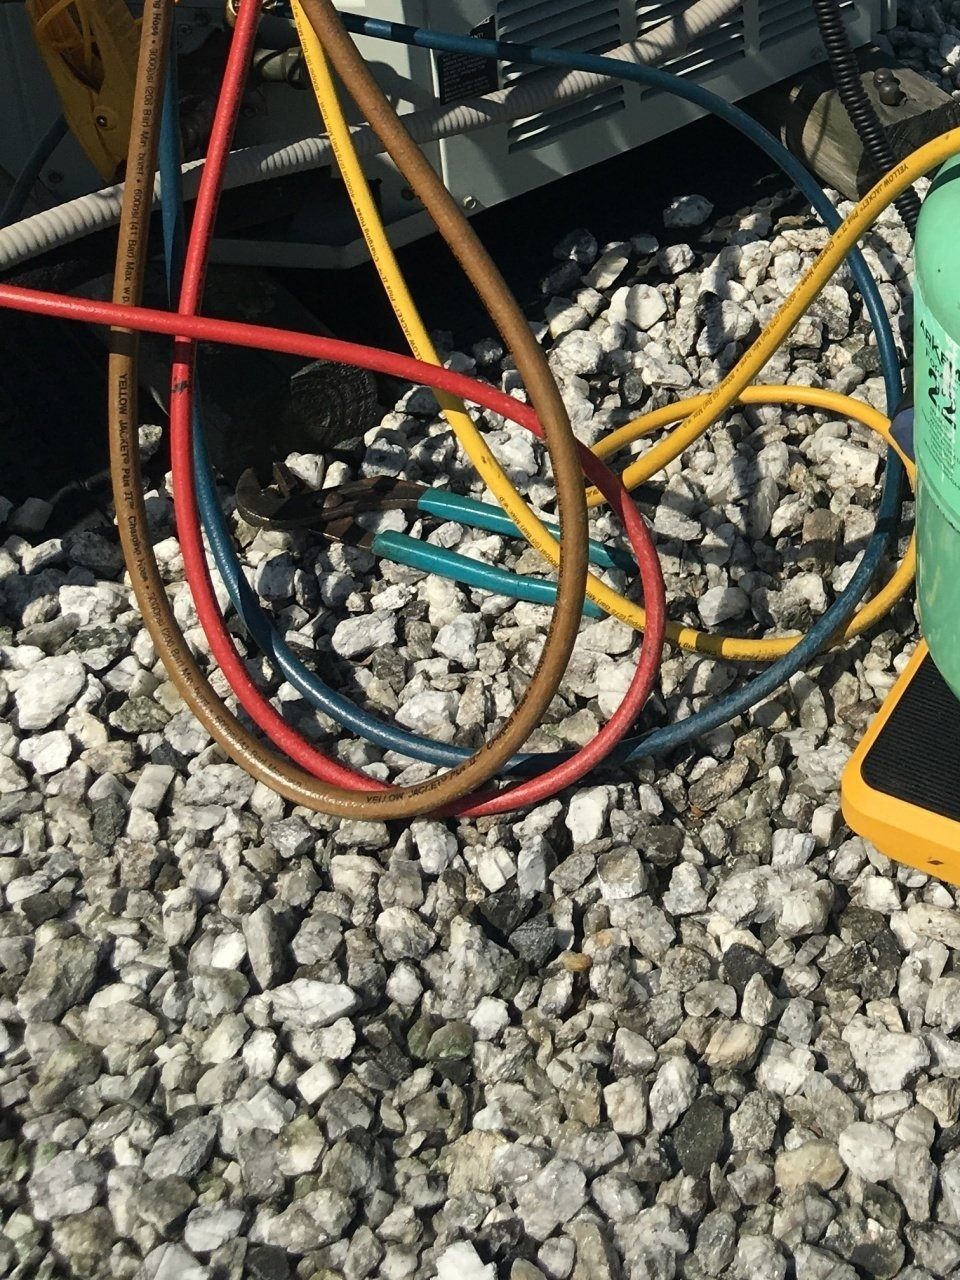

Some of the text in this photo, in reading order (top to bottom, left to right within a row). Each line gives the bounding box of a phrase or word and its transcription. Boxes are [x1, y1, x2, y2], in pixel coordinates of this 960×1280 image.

[884, 163, 909, 188] YELLOW
[117, 373, 129, 415] YELLOW
[366, 792, 404, 804] YELLOW
